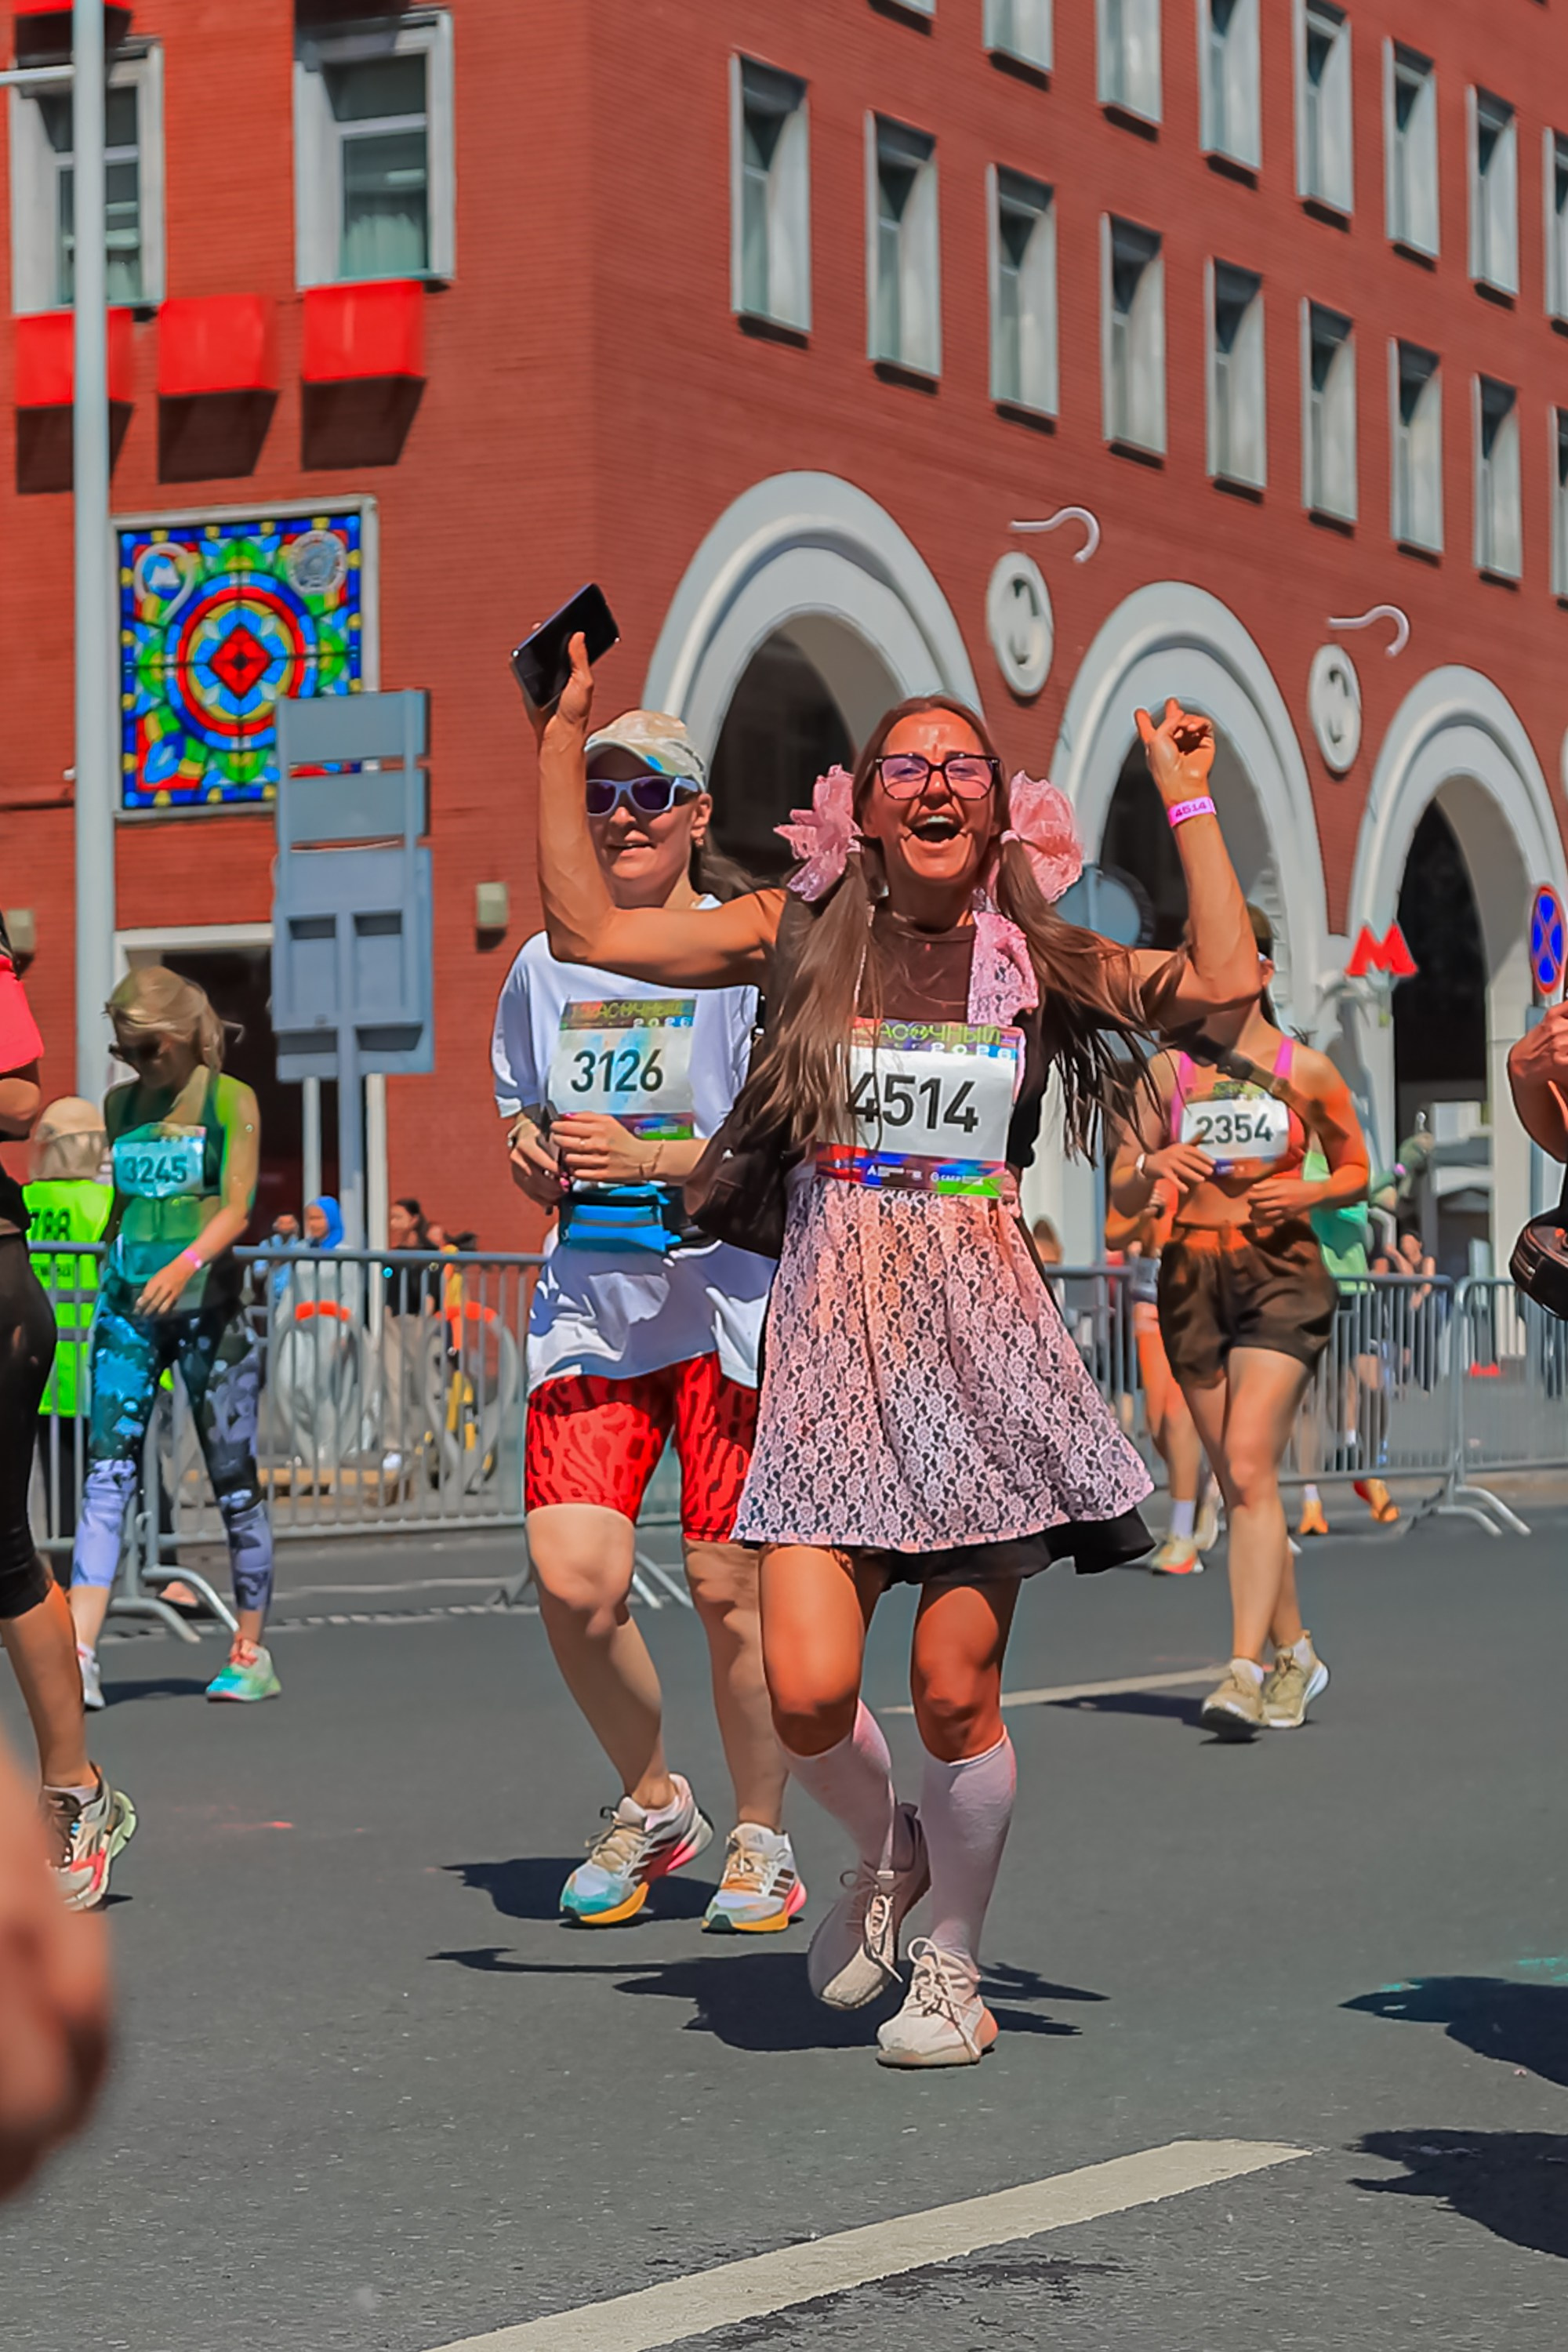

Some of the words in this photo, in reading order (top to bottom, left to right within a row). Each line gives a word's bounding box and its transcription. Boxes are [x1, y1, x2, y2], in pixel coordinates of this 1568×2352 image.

[570, 1048, 663, 1093] 3126
[847, 1071, 979, 1134] 4514
[1196, 1112, 1274, 1144] 2354
[122, 1156, 187, 1184] 3245
